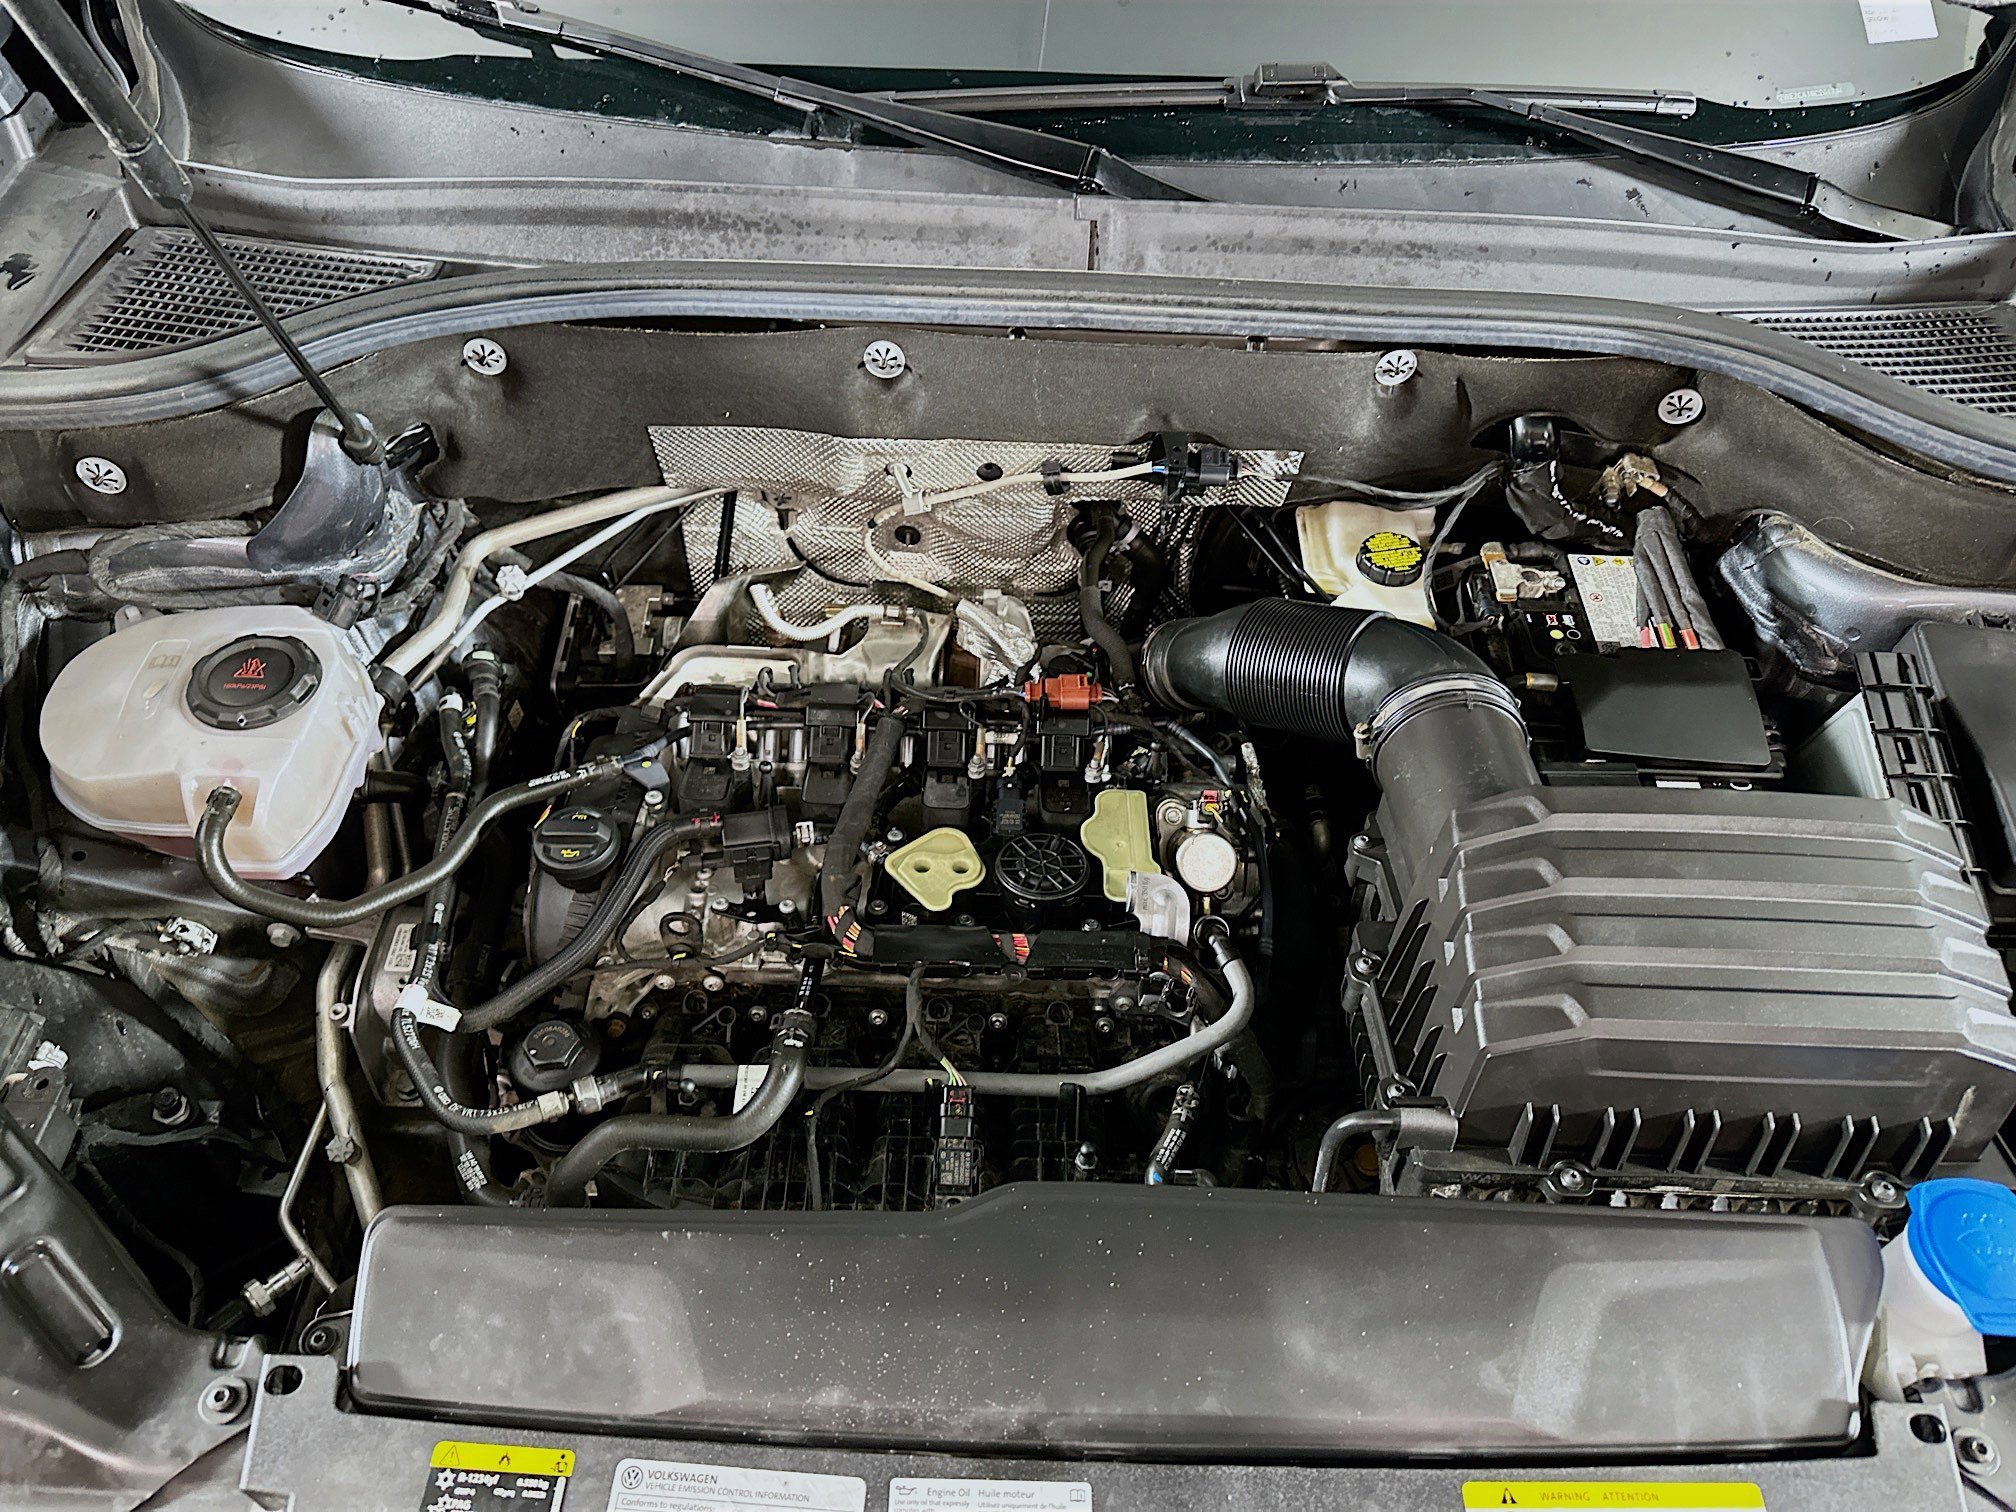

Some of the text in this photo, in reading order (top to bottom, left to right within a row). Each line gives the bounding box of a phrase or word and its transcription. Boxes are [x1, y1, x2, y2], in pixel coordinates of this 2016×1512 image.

[647, 1469, 718, 1484] VOLKSWAGEN
[645, 1482, 810, 1502] VEHICLE EMISSION CONTROL INFORMATION
[927, 1487, 970, 1498] Engine Oil
[978, 1489, 1035, 1499] Huile moteur
[1539, 1491, 1660, 1502] WARNING ATTENTION
[621, 1497, 659, 1508] Conforms
[660, 1501, 668, 1509] to
